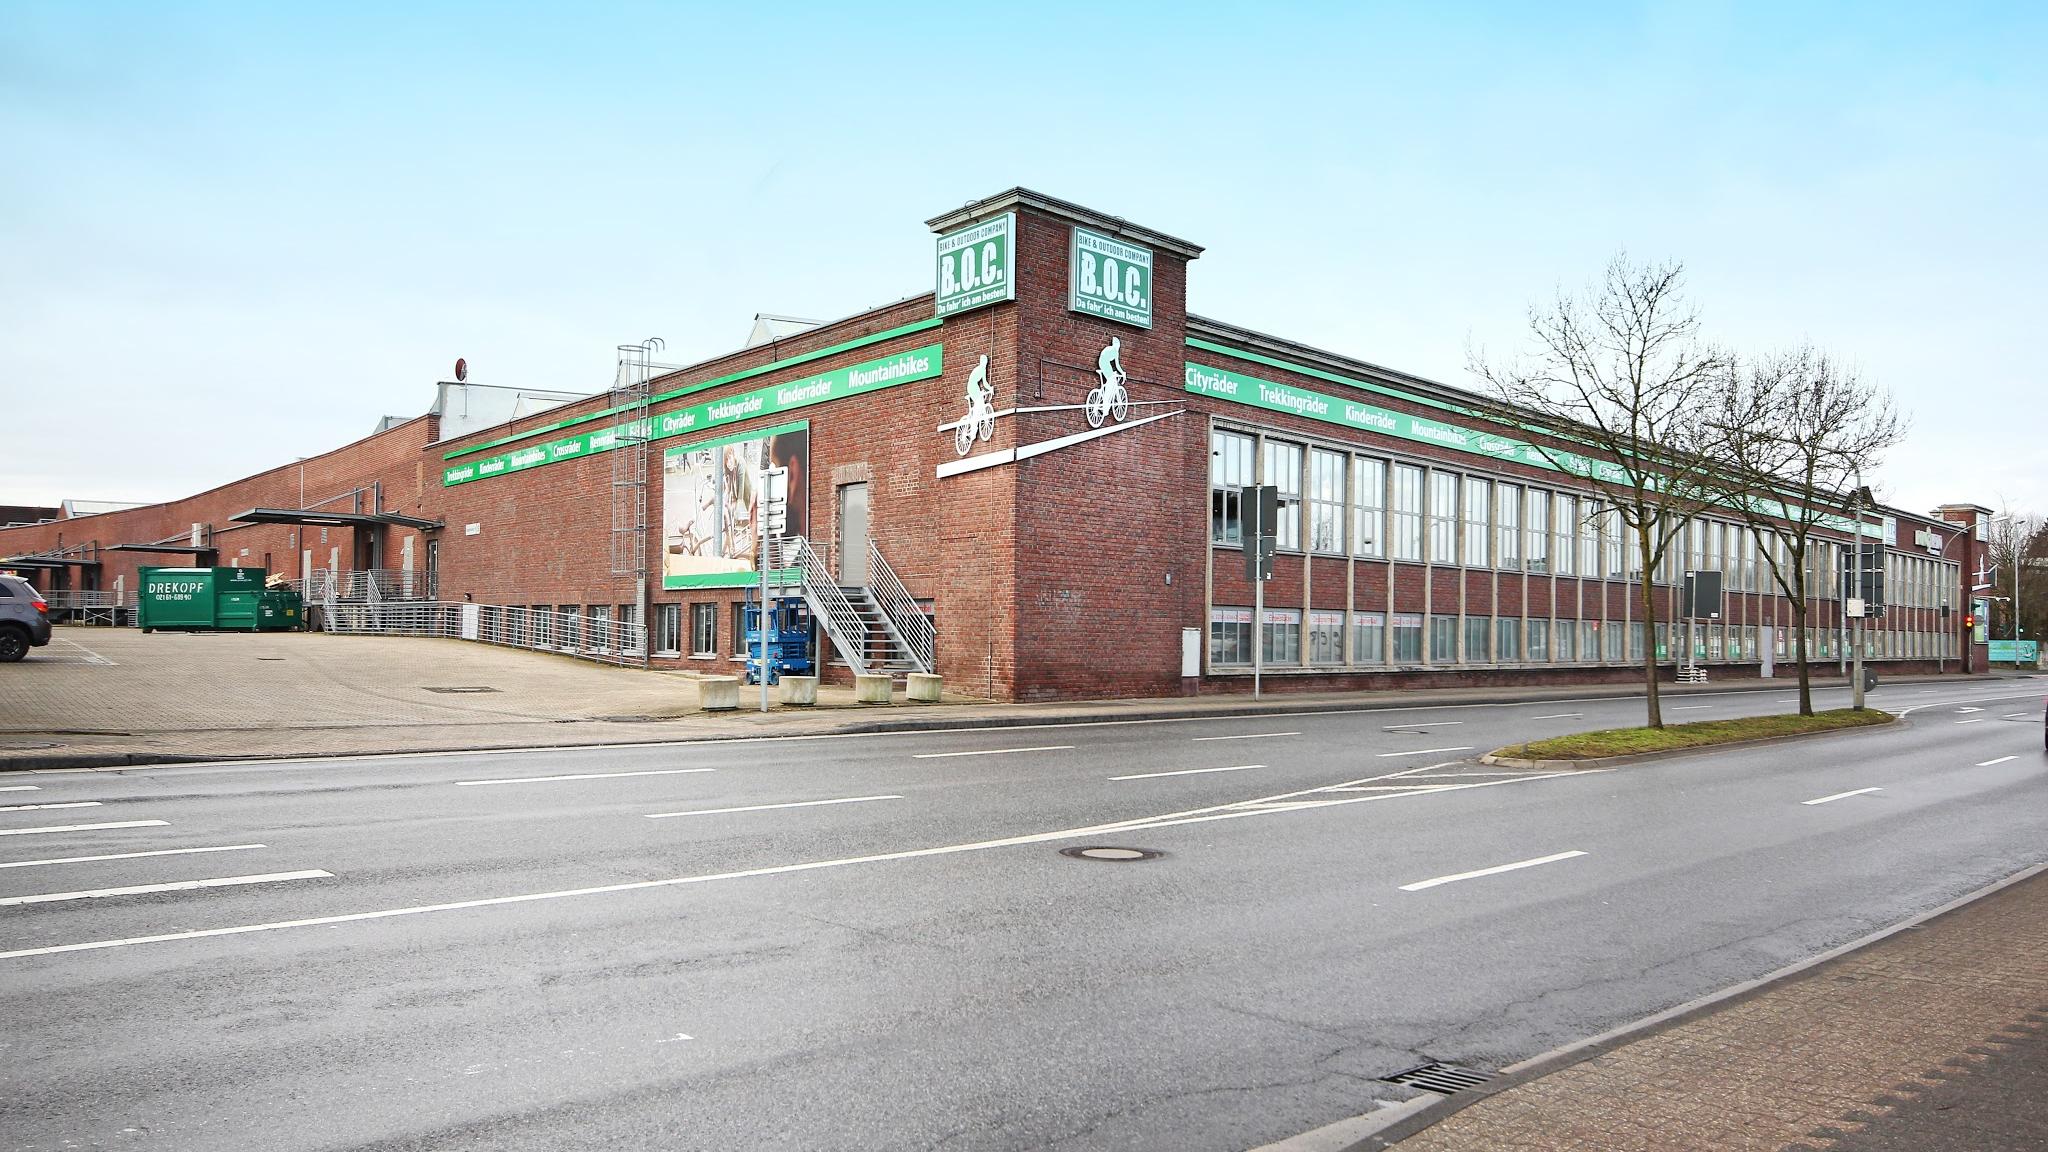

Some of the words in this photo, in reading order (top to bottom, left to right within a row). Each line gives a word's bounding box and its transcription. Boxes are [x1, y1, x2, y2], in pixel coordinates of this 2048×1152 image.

[940, 240, 951, 252] BIKE
[957, 230, 980, 247] OUTDOOR
[981, 222, 1006, 238] COMPANY
[1079, 235, 1091, 248] BIKE
[1092, 239, 1097, 248] &
[1098, 241, 1123, 257] OUTDOOR
[1124, 250, 1150, 265] COMPANY
[940, 241, 1003, 298] B.O.C.
[1080, 251, 1147, 309] B.O.C.
[937, 304, 946, 315] Da
[961, 297, 971, 307] ich
[971, 295, 982, 304] am
[982, 285, 1007, 302] besten!
[1076, 297, 1086, 308] Da
[1103, 304, 1114, 316] ich
[1114, 308, 1125, 319] am
[1125, 310, 1150, 326] besten!
[663, 411, 695, 433] Cityräder
[708, 395, 763, 422] Trekkingräder
[777, 378, 832, 406] Kinderräder
[848, 356, 929, 389] Mountainbikes
[1185, 367, 1239, 396] Cityräder
[1258, 383, 1329, 415] Trekkingräder
[1345, 404, 1397, 431] Kinderräder
[1411, 420, 1467, 446] Mountainbikes
[148, 582, 204, 594] DREKOPF
